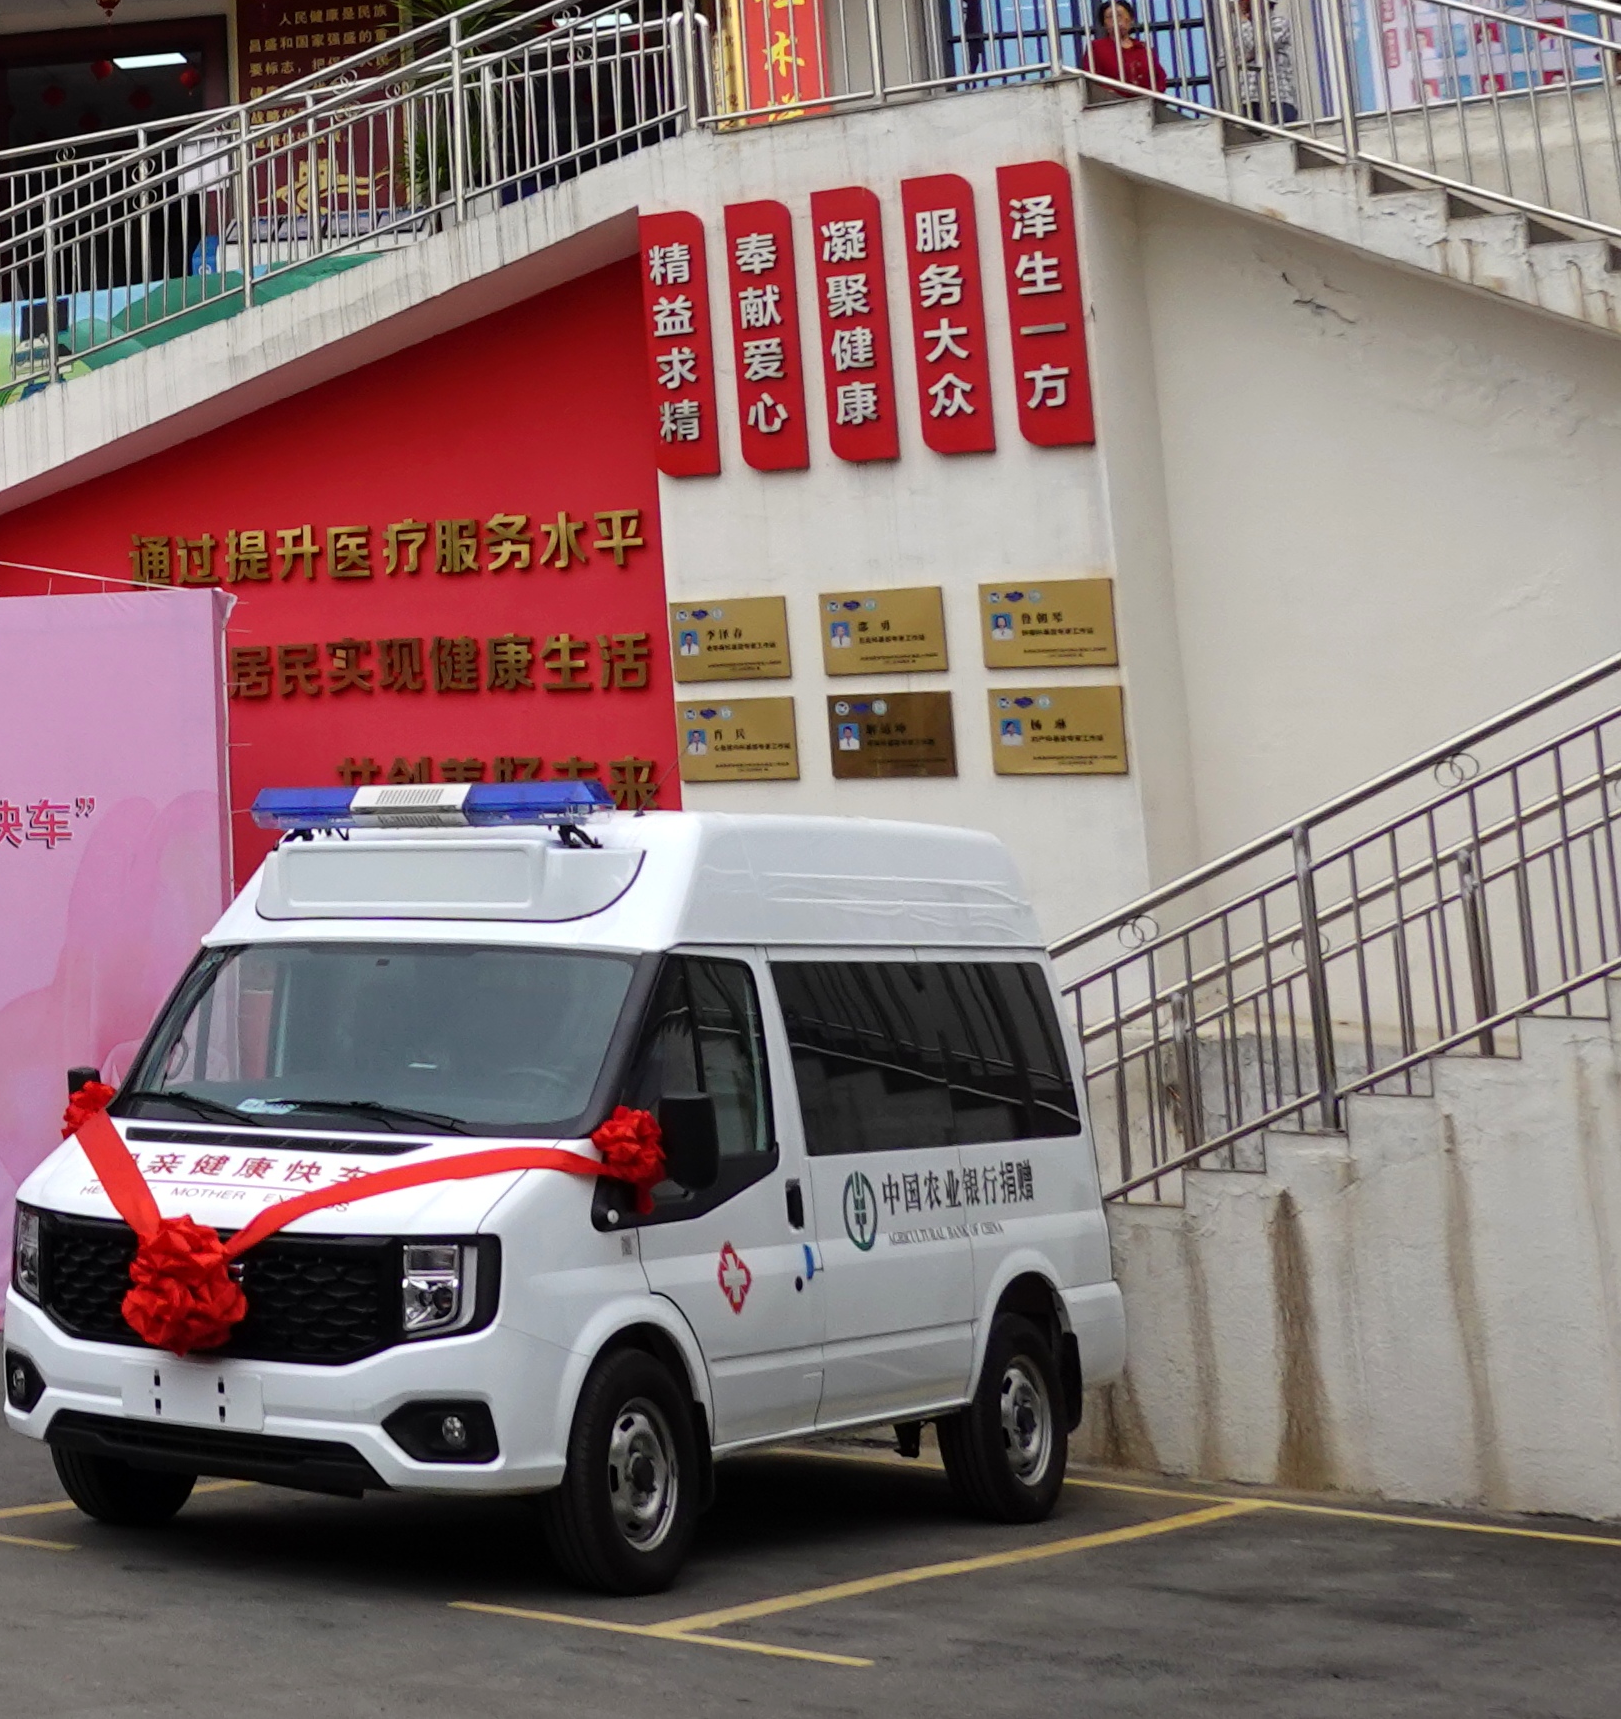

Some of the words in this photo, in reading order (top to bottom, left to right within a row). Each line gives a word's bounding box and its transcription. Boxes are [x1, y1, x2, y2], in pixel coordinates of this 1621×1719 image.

[647, 243, 700, 444] 精益求精
[736, 232, 789, 433] 奉献爱心
[821, 218, 878, 426] 凝聚健康
[915, 209, 974, 418] 服务大众
[1010, 195, 1070, 410] 泽生一方
[129, 508, 644, 584] 通过提升医疗服务水平
[229, 632, 649, 698] 居民实现健康生活
[170, 1186, 246, 1201] MOTHER
[882, 1159, 1035, 1215] 中国农业银行捐赠
